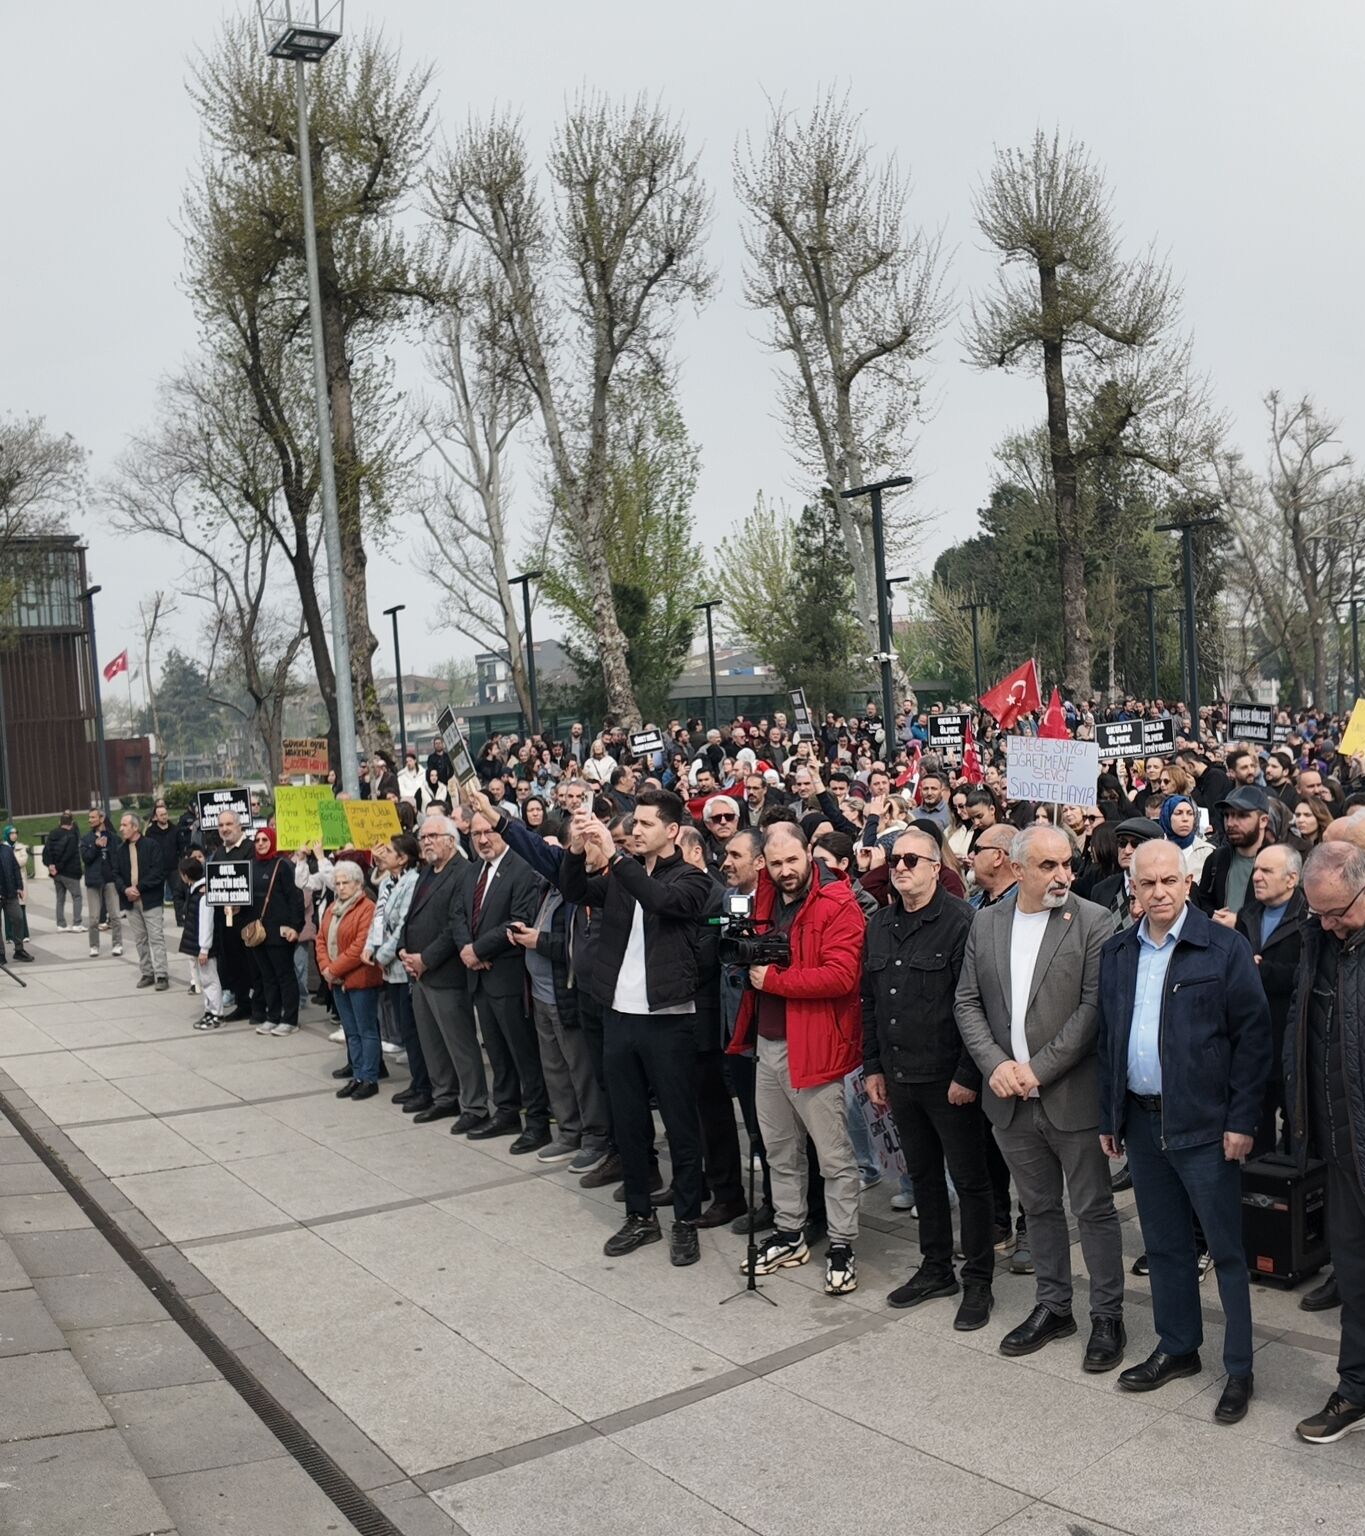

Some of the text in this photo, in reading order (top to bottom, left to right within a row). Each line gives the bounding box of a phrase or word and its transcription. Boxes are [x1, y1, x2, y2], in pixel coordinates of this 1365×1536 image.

[1105, 724, 1133, 735] OKULDA
[1108, 733, 1131, 746] ÖLMEK
[1053, 740, 1089, 757] SAYGI
[1099, 743, 1142, 757] İSTEMİYORUZ
[1060, 785, 1096, 806] HAYIR
